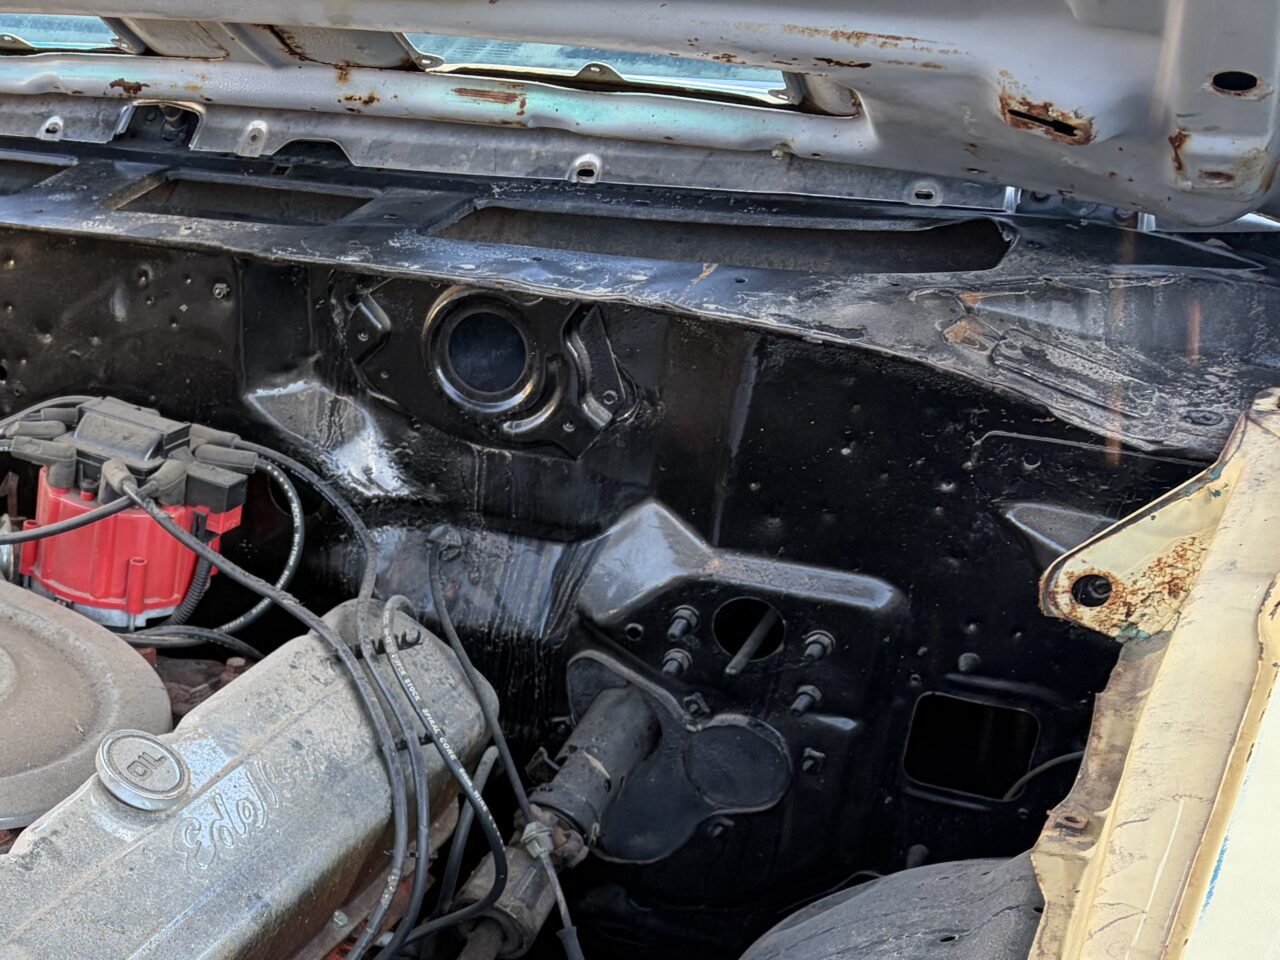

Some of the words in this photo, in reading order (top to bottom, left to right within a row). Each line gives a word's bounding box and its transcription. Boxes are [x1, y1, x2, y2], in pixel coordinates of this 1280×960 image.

[126, 751, 166, 779] OIL
[405, 678, 421, 702] STOCK
[422, 708, 440, 734] SPIRAL
[439, 736, 457, 761] CORE
[473, 789, 488, 812] WIRE
